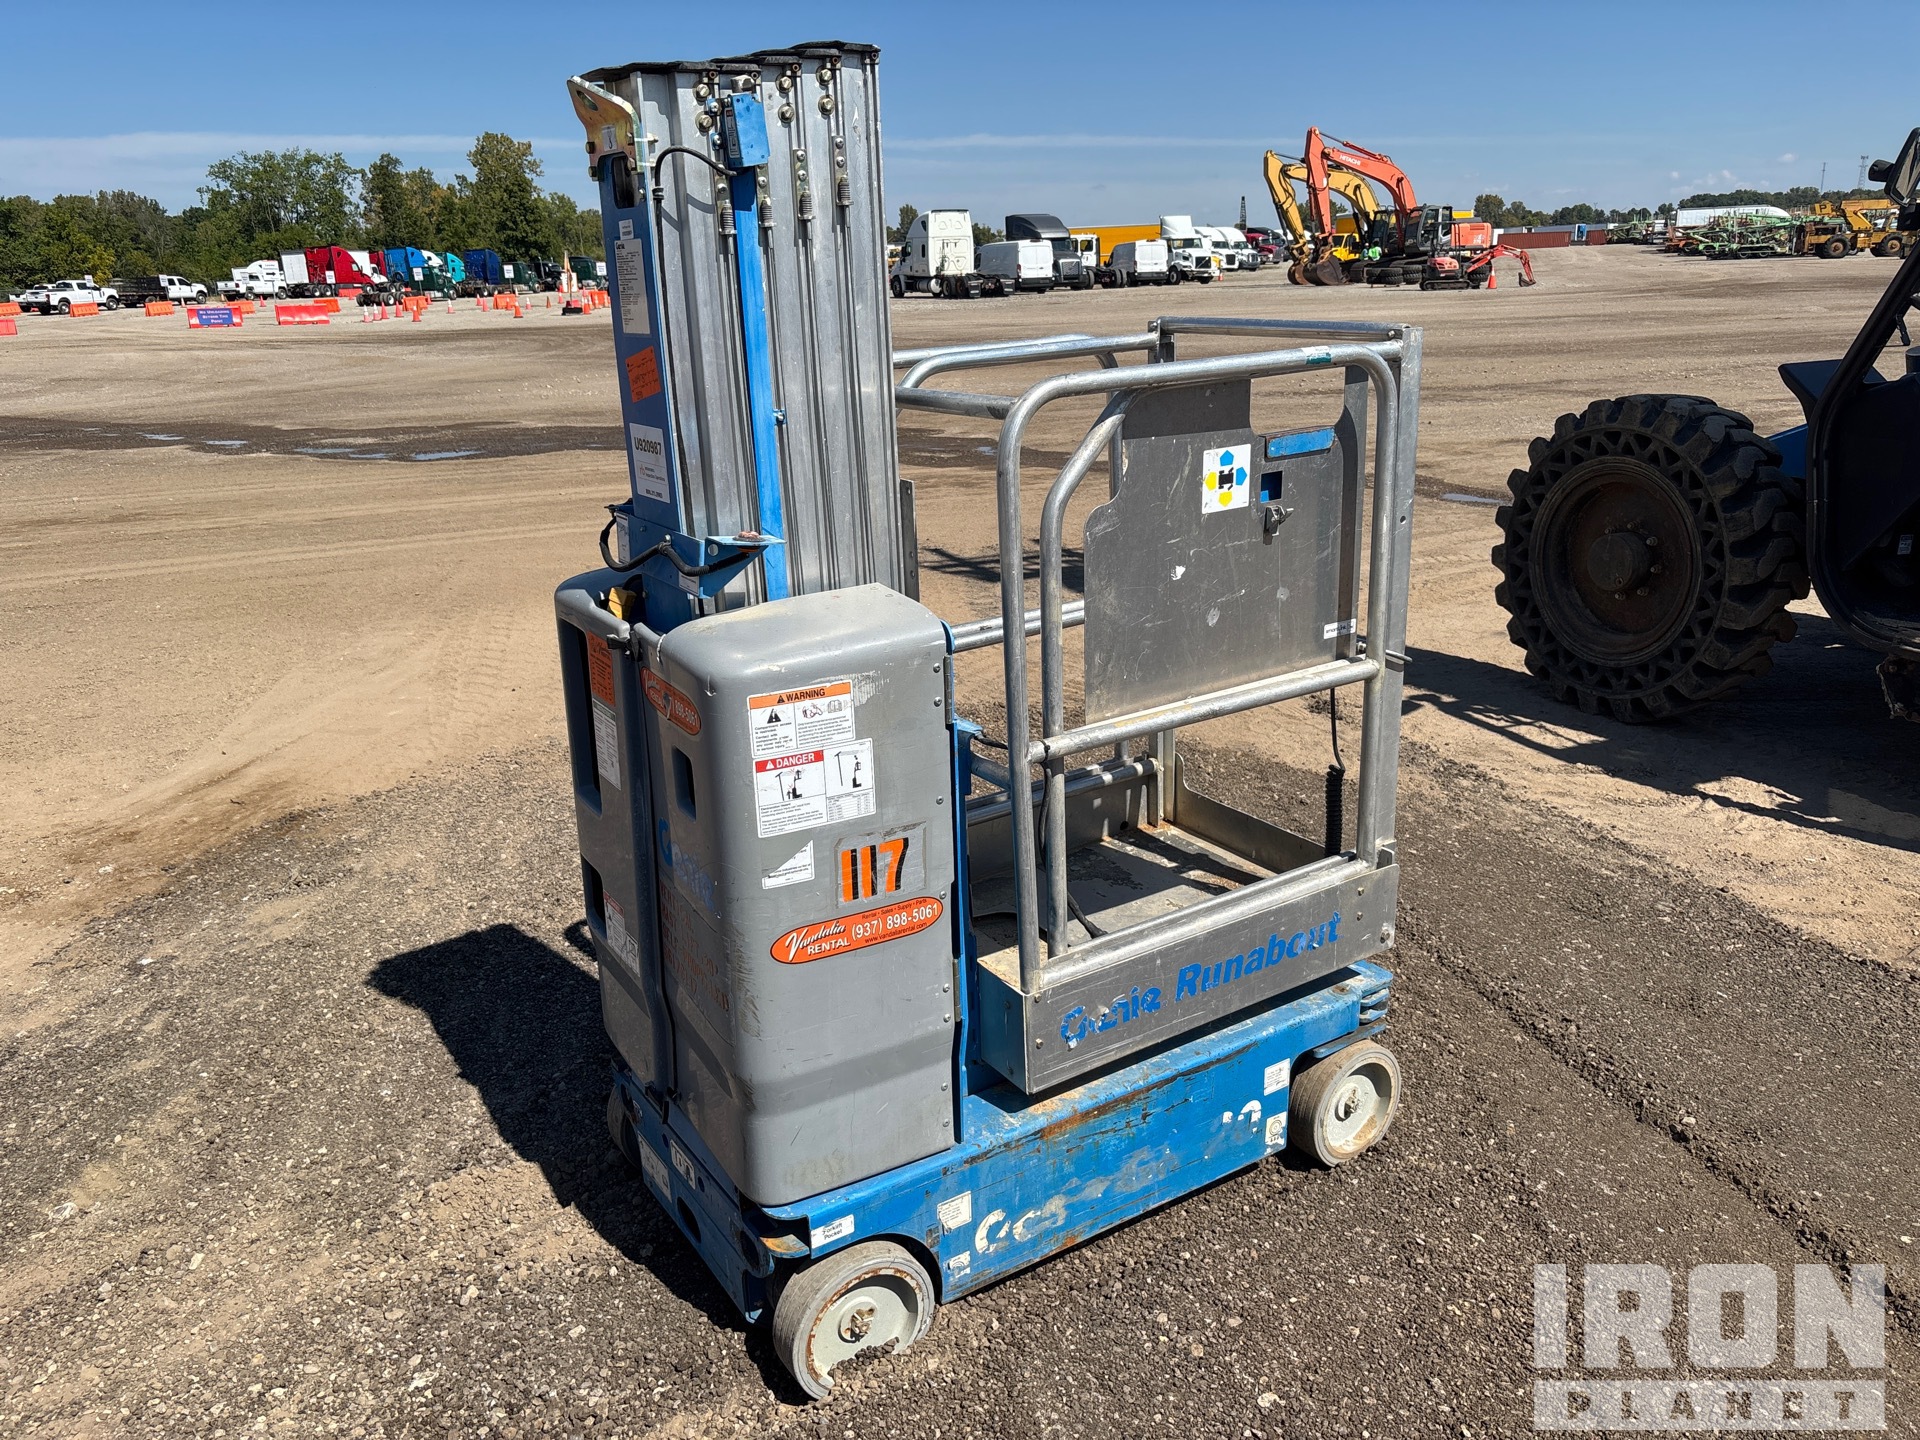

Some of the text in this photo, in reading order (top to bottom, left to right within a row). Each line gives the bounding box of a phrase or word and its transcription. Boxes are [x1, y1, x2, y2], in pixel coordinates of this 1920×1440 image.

[1339, 154, 1361, 166] HITACHI
[785, 688, 826, 702] WARNING
[776, 753, 815, 768] DANGER
[840, 836, 909, 903] 117
[861, 911, 877, 920] Rental
[880, 908, 894, 916] Sales
[897, 902, 913, 912] Supply
[807, 903, 939, 956] RENTAL (937) 898-5061
[784, 920, 847, 962] Vandalia
[1060, 911, 1342, 1049] Genie Runabout
[824, 1229, 843, 1241] Pocket
